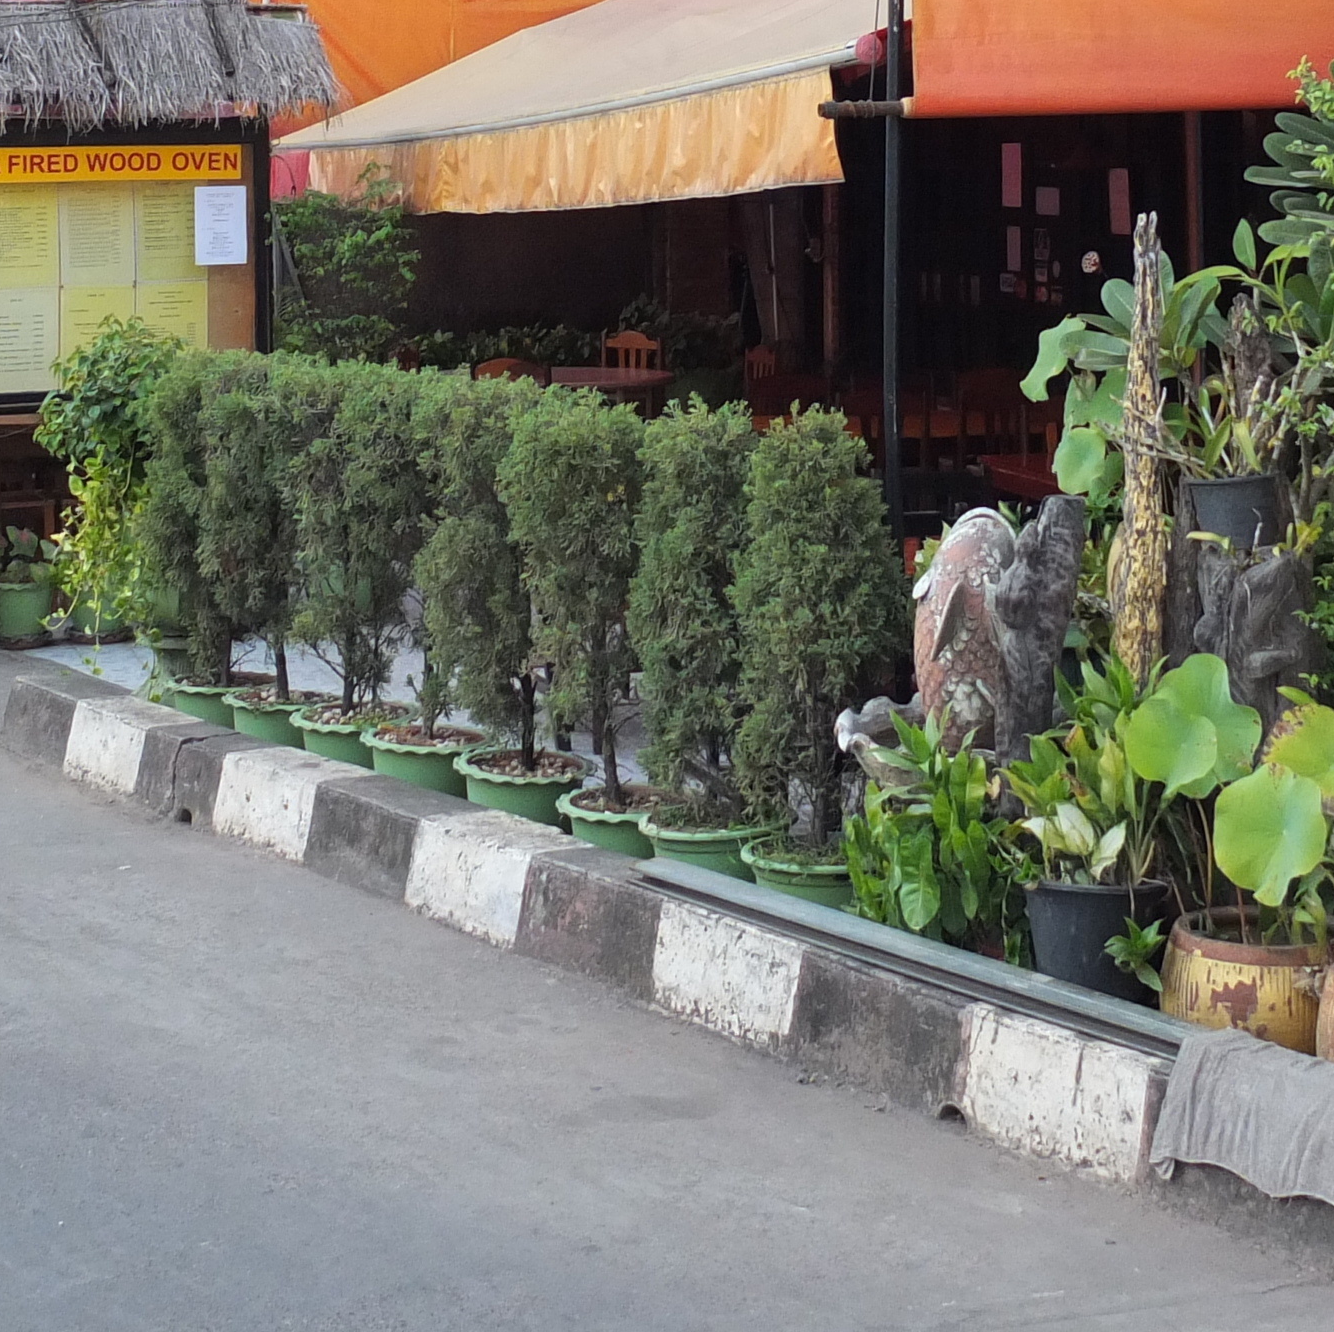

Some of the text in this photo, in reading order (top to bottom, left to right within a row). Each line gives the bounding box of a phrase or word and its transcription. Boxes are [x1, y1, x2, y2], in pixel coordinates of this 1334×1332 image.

[8, 154, 79, 174] FIRED
[86, 152, 162, 172] WOOD
[172, 151, 238, 171] OVEN
